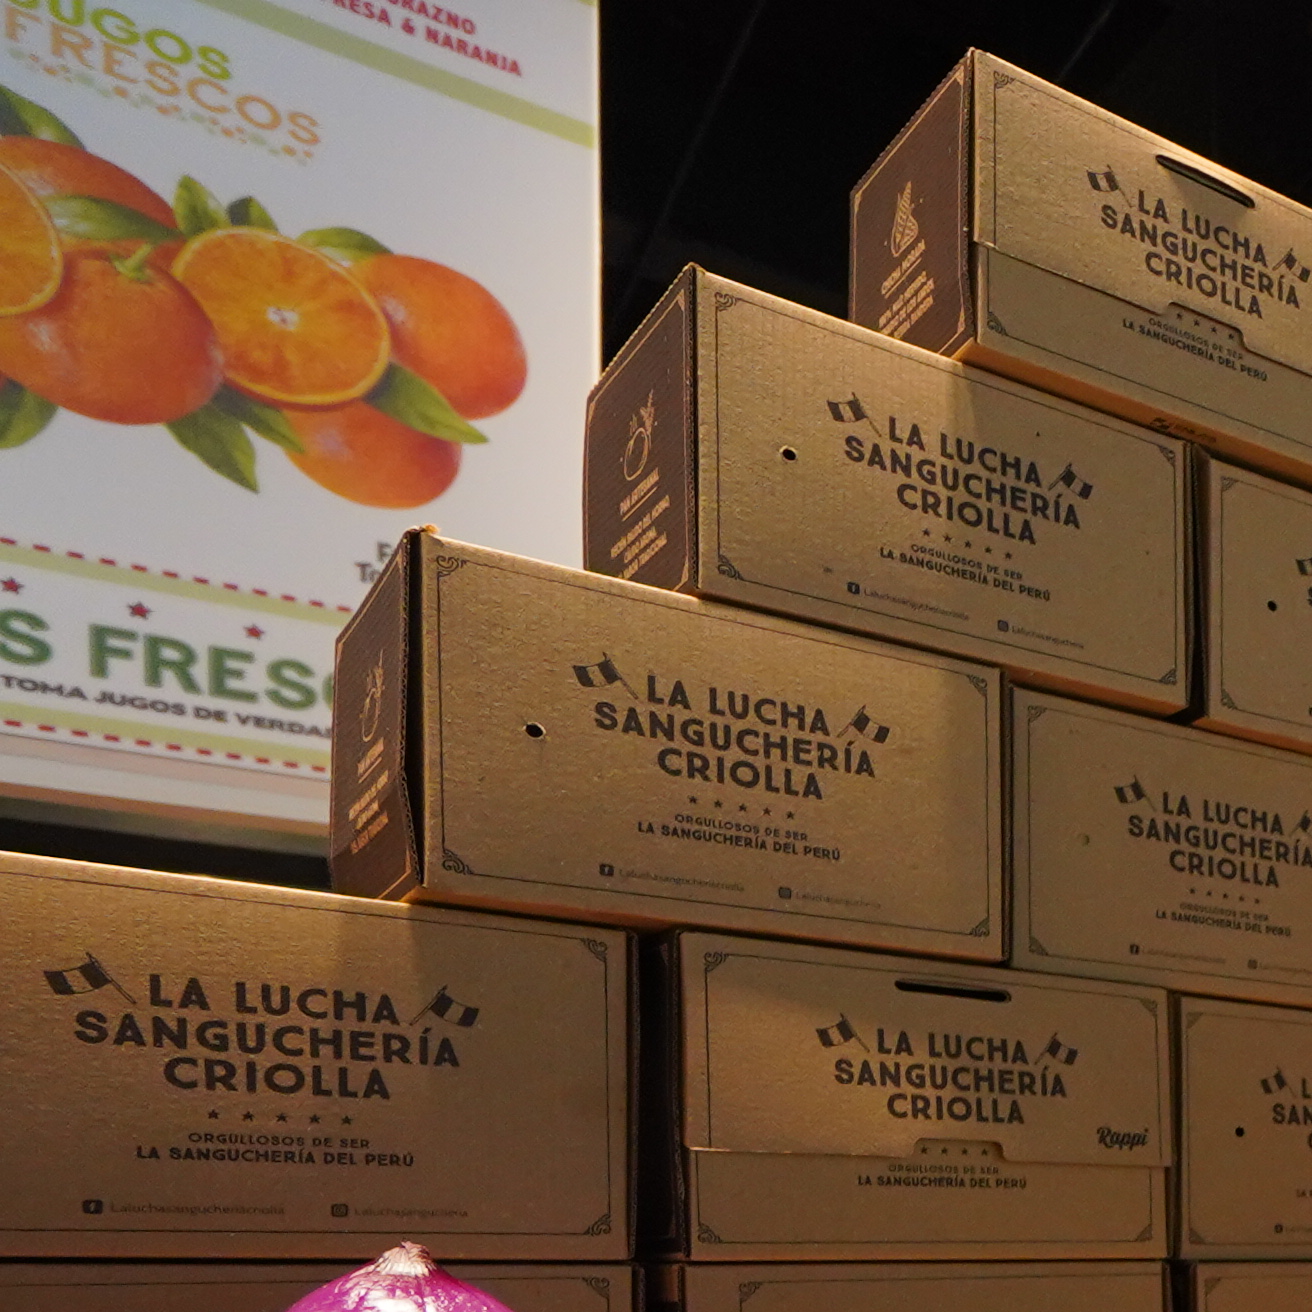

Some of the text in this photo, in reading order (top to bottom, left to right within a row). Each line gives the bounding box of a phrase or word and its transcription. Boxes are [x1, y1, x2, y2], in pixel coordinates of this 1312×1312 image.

[18, 0, 231, 80] UGOS
[387, 0, 475, 34] RAZNO
[5, 6, 320, 145] FRESCOS
[1138, 190, 1268, 268] LA LUCHA
[1101, 205, 1300, 309] SANGUCHERÍA
[1145, 252, 1262, 319] CRIOLLA
[1122, 318, 1135, 332] LA
[1218, 354, 1237, 371] DEL
[1240, 361, 1267, 382] PERÚ
[889, 416, 1042, 488] LA LUCHA
[844, 435, 1080, 529] SANGUCHERÍA
[897, 483, 1036, 545] CRIOLLA
[880, 547, 1050, 602] LA SANGUCHERÍA DEL PERÚ
[911, 543, 982, 569] ORGULLOSOS
[88, 624, 337, 711] FRES
[2, 675, 87, 701] TOMA
[95, 690, 189, 717] JUGOS
[193, 705, 228, 723] DE
[647, 674, 830, 736] LA LUCHA
[594, 701, 875, 778] SANGUCHERÍA
[657, 748, 823, 800] CRIOLLA
[674, 813, 760, 834] ORGULLOSOS
[785, 830, 808, 842] SER
[1162, 791, 1283, 835] LA LUCHA
[638, 821, 841, 861] LA SANGUCHERÍA DEL PERÚ
[1169, 850, 1279, 888] CRIOLLA
[148, 974, 400, 1026] LA LUCHA
[74, 1010, 460, 1068] SANGUCHERÍA
[876, 1028, 1029, 1065] LA LUCHA
[163, 1056, 390, 1100] CRIOLLA
[834, 1058, 1068, 1098] SANGUCHERÍA
[887, 1093, 1025, 1125] CRIOLLA
[136, 1146, 414, 1167] LA SANGUCHERÍA DEL PERÚ
[188, 1132, 305, 1148] ORGULLOSOS
[339, 1137, 370, 1149] SER
[1096, 1126, 1148, 1152] Rappi
[857, 1175, 872, 1187] LA
[970, 1177, 992, 1189] DEL
[996, 1176, 1027, 1190] PERÚ
